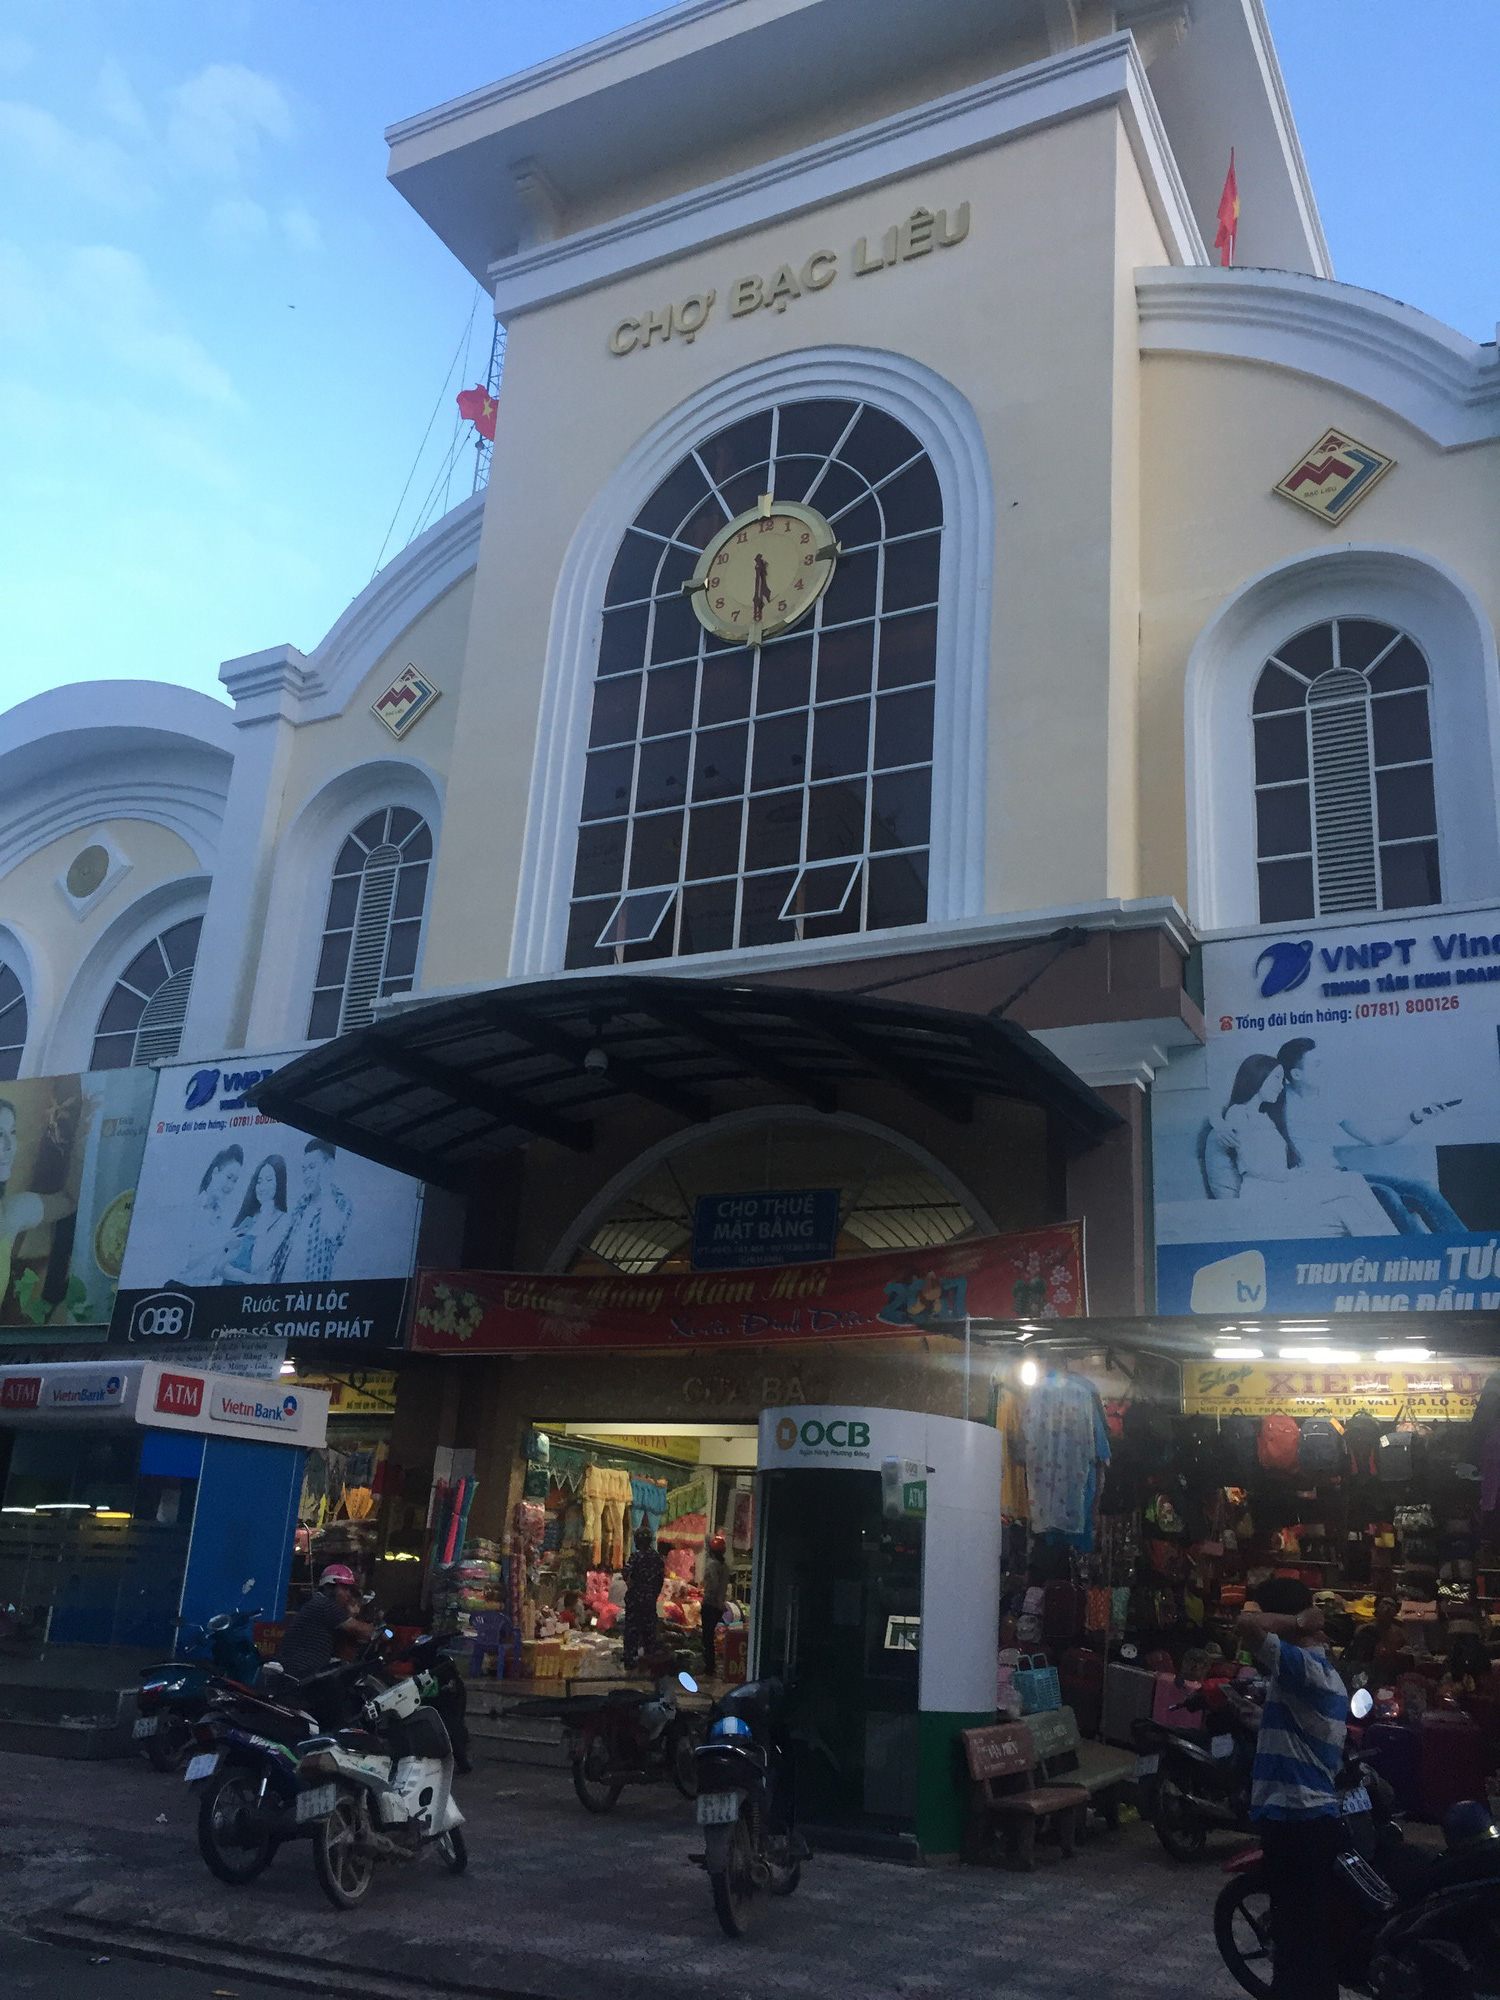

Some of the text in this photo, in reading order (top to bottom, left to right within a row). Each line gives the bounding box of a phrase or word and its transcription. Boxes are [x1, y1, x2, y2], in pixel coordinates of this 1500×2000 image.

[608, 201, 970, 355] CHỢ BẠC LIÊU
[758, 518, 775, 534] 12
[784, 521, 791, 532] 1
[736, 531, 749, 544] 11
[800, 533, 810, 544] 2
[717, 553, 729, 565] 10
[804, 555, 814, 565] 3
[711, 577, 720, 588] 9
[795, 579, 804, 590] 4
[716, 598, 725, 609] 8
[778, 600, 787, 611] 5
[732, 611, 740, 622] 7
[1321, 938, 1417, 973] VNPT
[1235, 995, 1460, 1031] Tổng đài bán hàng: (0781) 800126
[717, 1193, 815, 1218] CHO THUÊ
[713, 1219, 755, 1244] MẶT
[1296, 1254, 1379, 1285] TRUYỀN
[1382, 1256, 1441, 1282] HÌNH
[242, 1289, 349, 1314] Rước TÀI LỘC
[1237, 1279, 1261, 1303] tv
[1335, 1290, 1409, 1313] HÀNG
[138, 1307, 183, 1336] 088
[274, 1321, 321, 1338] SONG
[324, 1314, 374, 1339] PHÁT
[7, 1383, 107, 1401] ATM VietinBank
[164, 1383, 284, 1421] ATM VietinBank
[800, 1420, 870, 1447] OCB
[909, 1487, 925, 1508] ATM
